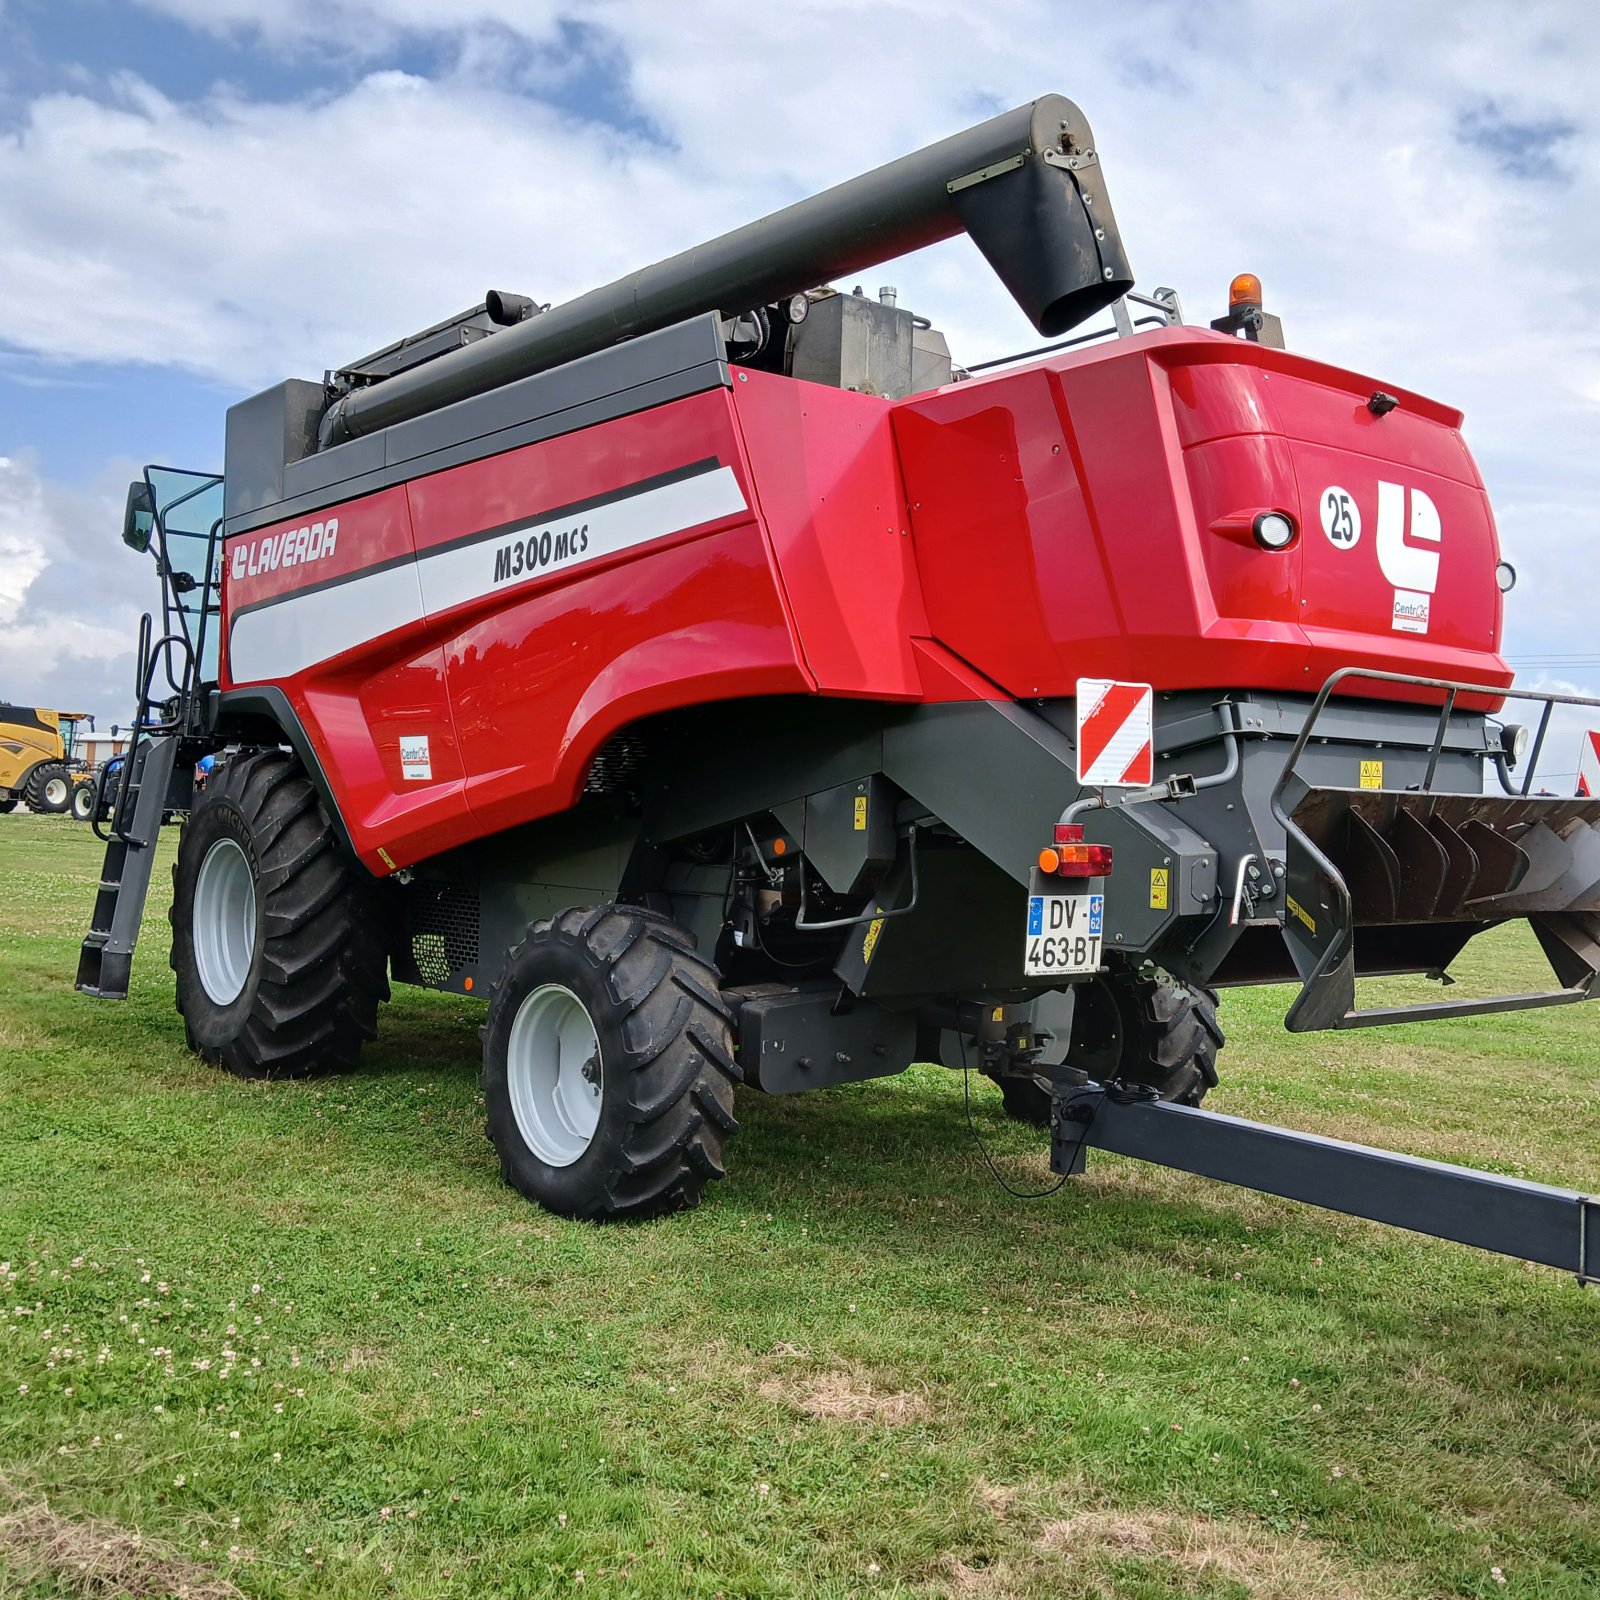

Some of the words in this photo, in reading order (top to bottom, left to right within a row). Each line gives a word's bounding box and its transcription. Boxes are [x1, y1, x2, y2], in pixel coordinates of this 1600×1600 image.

[1328, 493, 1353, 542] 25
[248, 518, 339, 576] LAVERDA
[1032, 920, 1039, 930] F
[1090, 917, 1101, 930] 62
[1028, 936, 1101, 968] 463-BT
